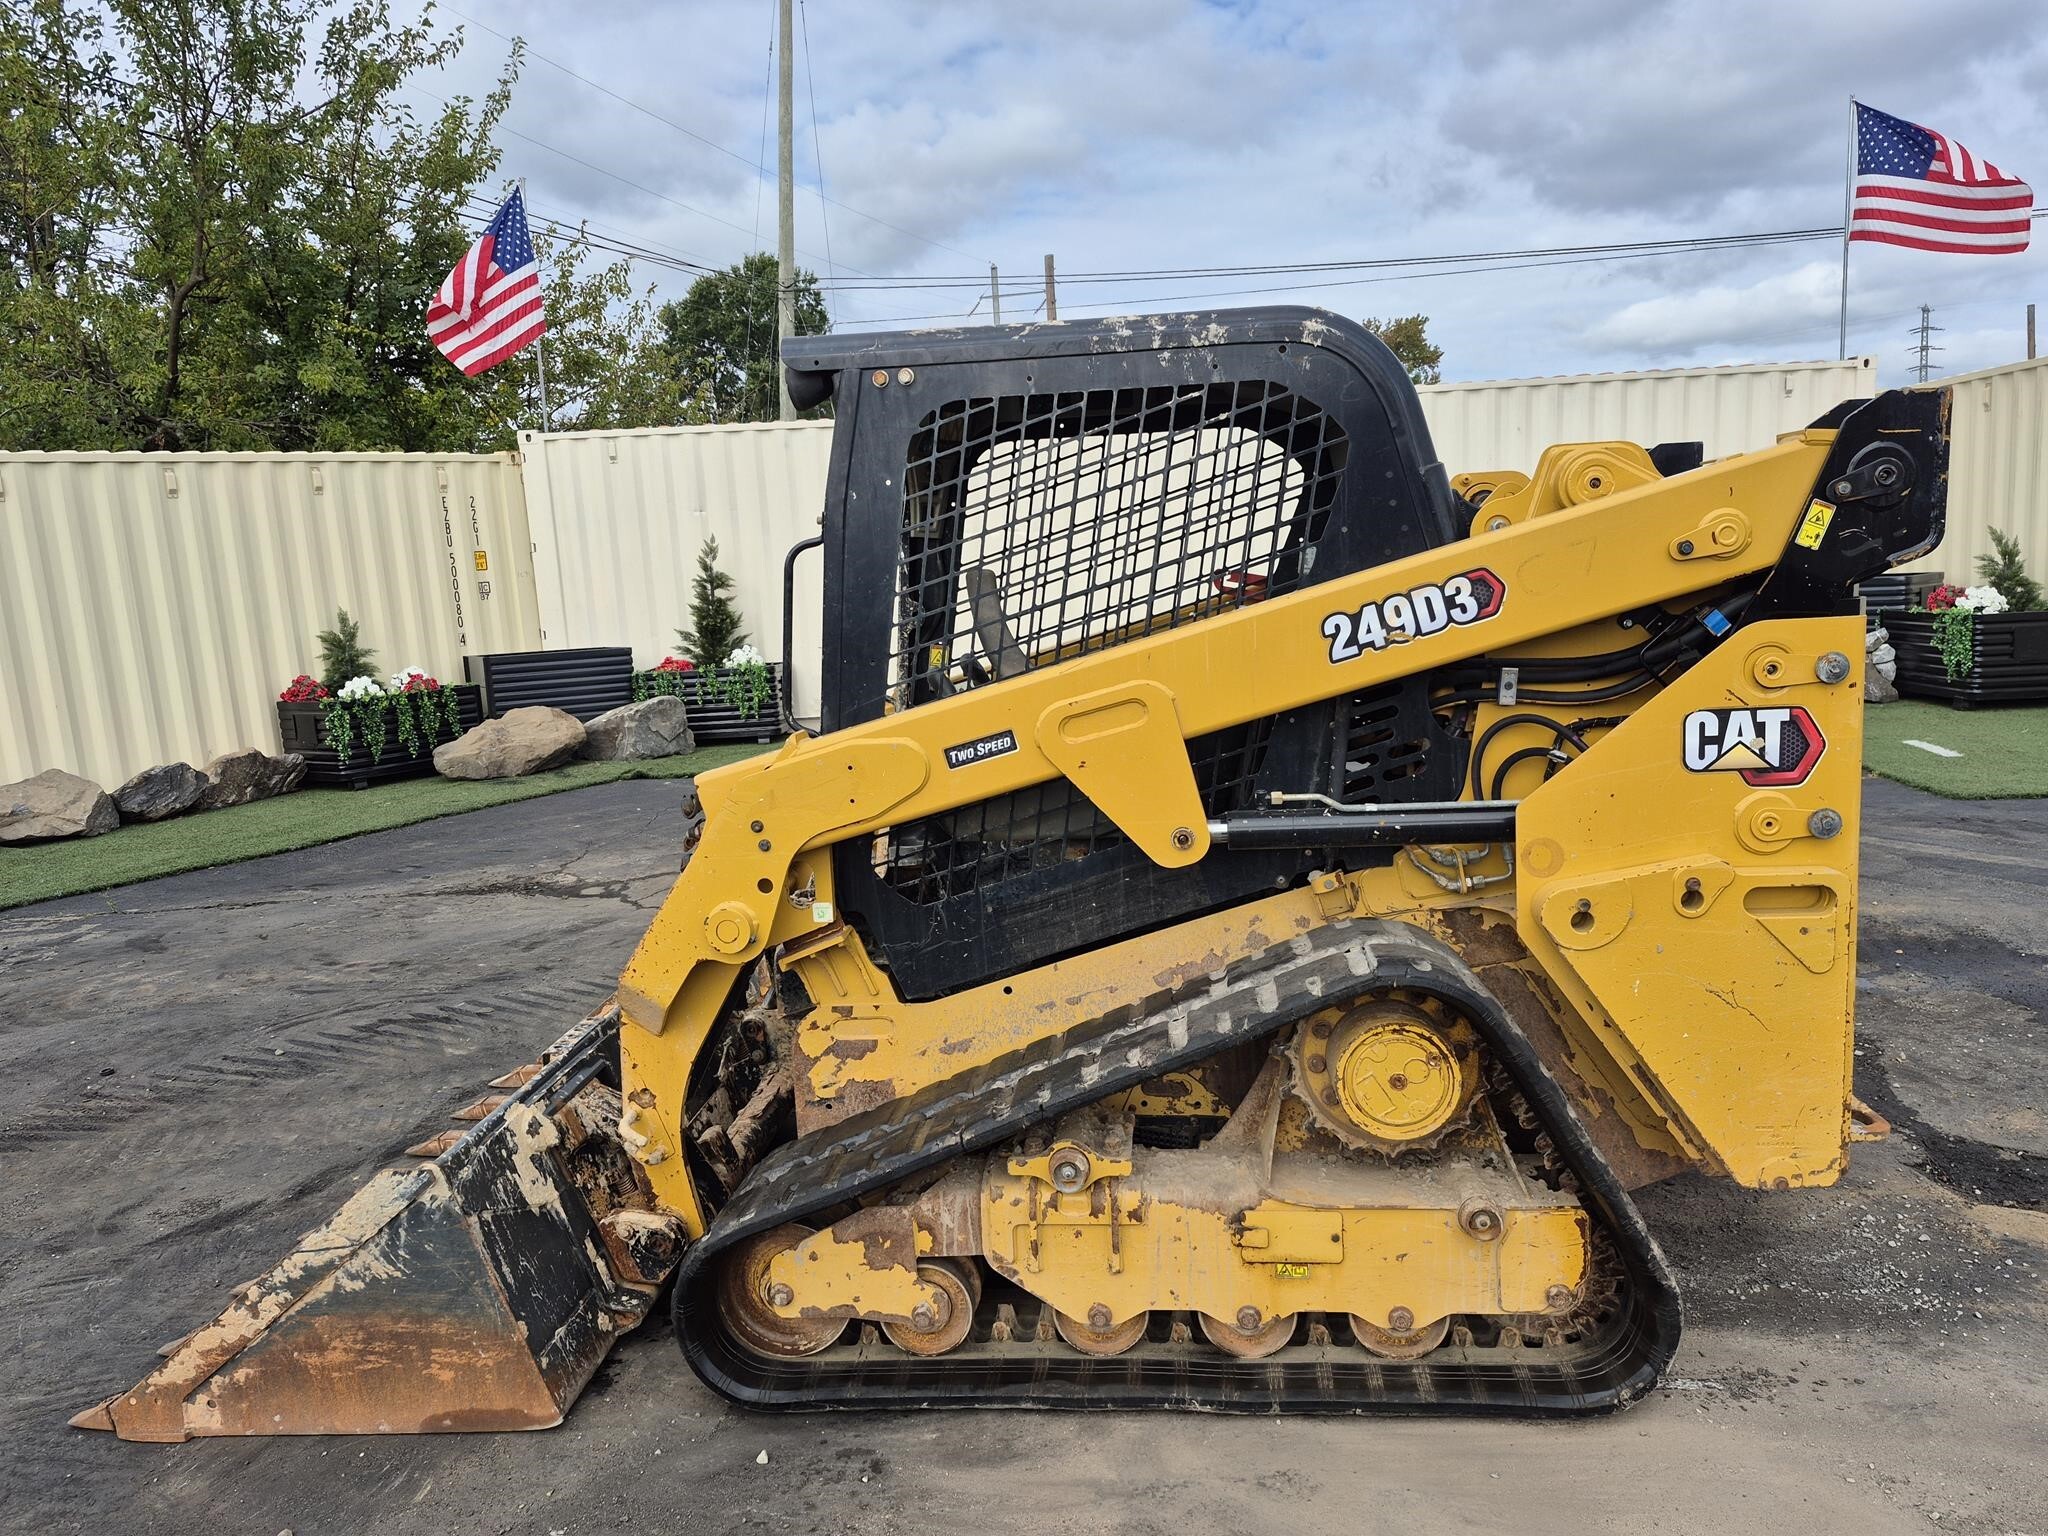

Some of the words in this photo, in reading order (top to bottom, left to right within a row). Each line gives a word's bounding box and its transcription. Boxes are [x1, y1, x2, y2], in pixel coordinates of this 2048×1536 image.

[469, 495, 480, 546] 22G1
[441, 496, 453, 548] EZBU
[449, 552, 464, 628] 500080
[460, 633, 466, 646] 4
[1323, 576, 1479, 661] 249D3
[1685, 708, 1791, 771] CAT
